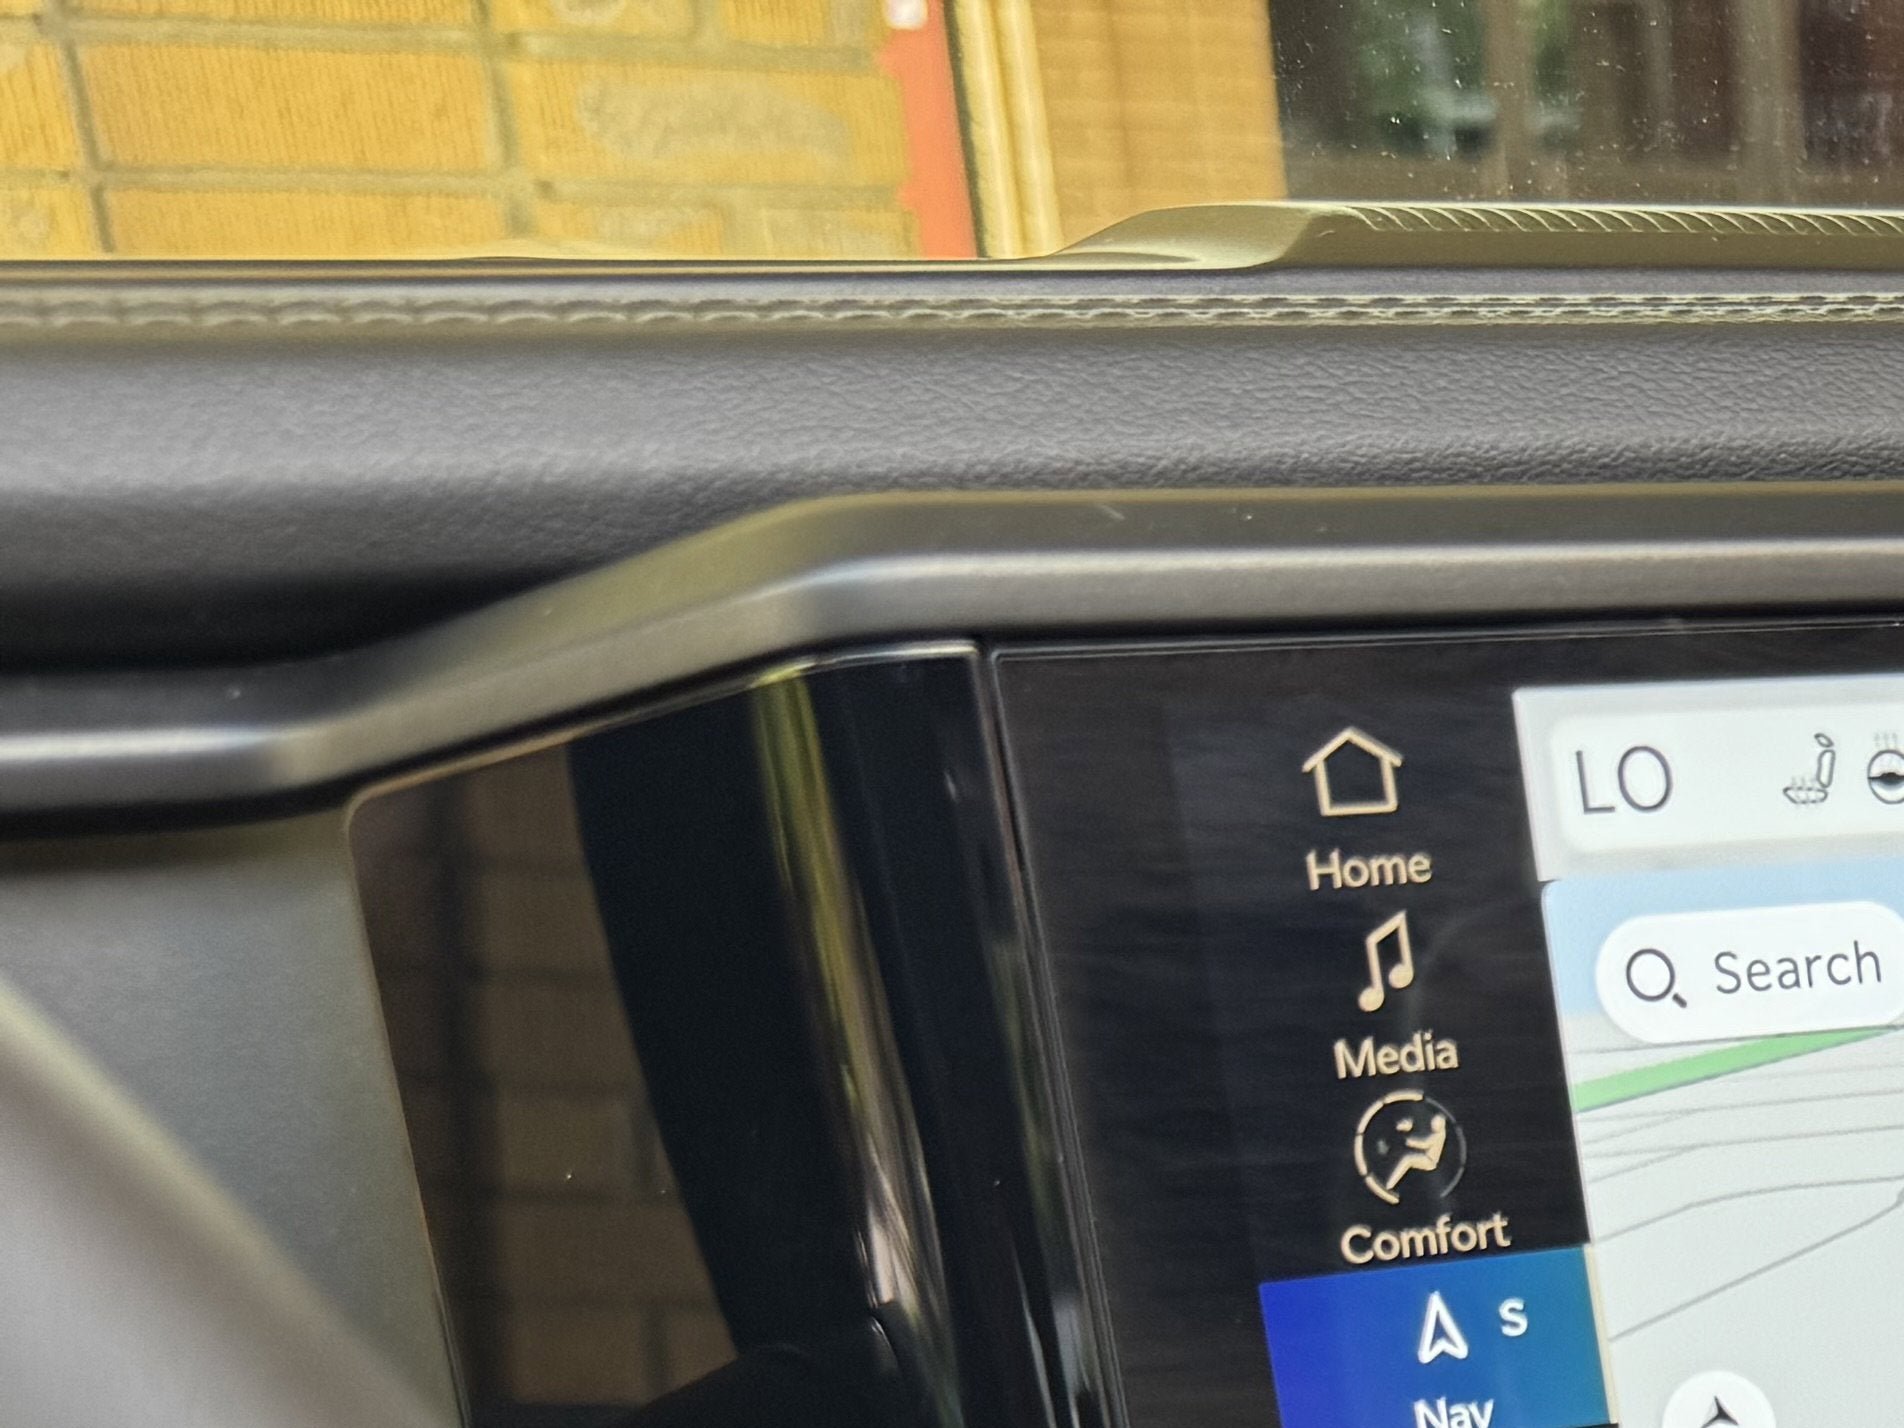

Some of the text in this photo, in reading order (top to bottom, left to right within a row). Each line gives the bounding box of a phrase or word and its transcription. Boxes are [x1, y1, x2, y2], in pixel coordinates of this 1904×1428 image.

[1574, 745, 1673, 814] LO
[1306, 849, 1432, 891] Home
[1714, 941, 1882, 995] Search
[1334, 1033, 1458, 1080] Media
[1340, 1211, 1511, 1264] Comfort
